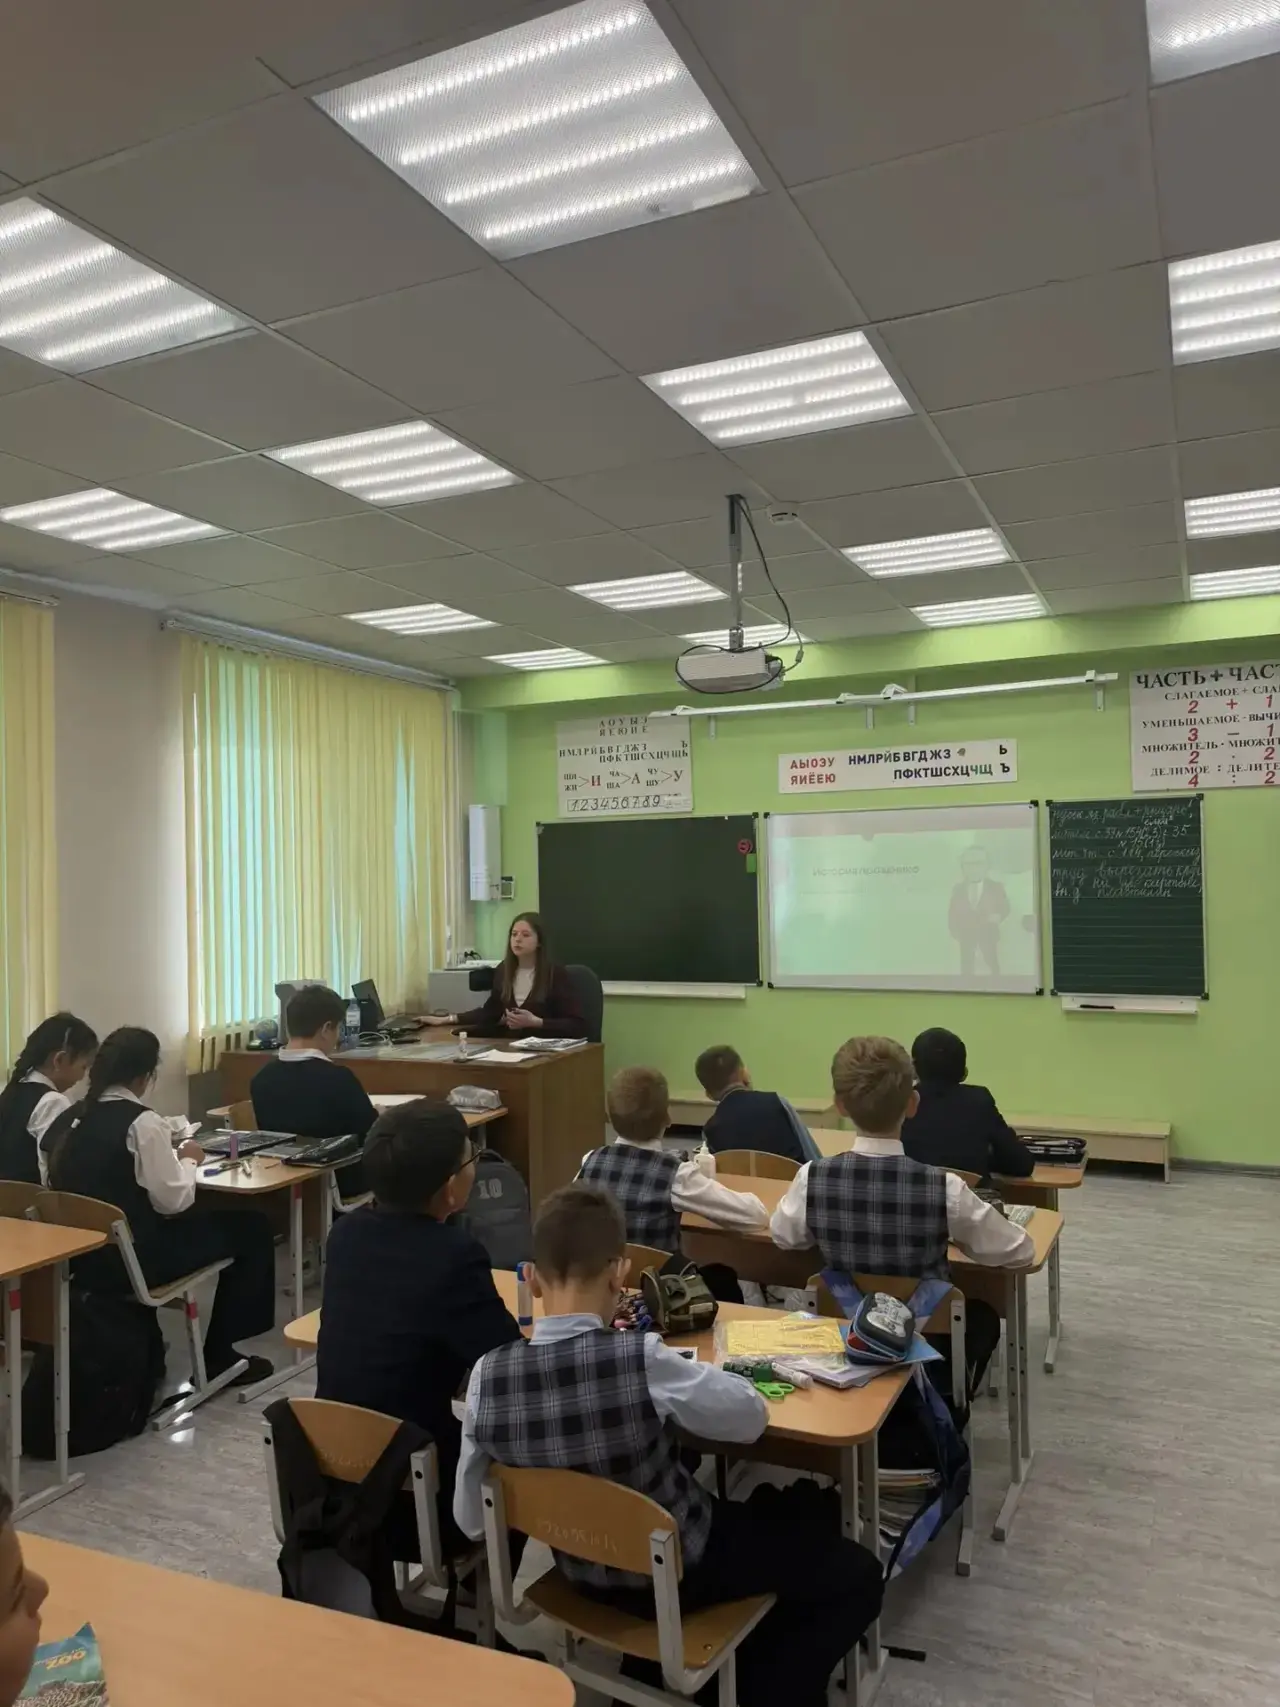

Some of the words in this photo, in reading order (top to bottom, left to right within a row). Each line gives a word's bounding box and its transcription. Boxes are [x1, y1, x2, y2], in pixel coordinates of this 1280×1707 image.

[1136, 670, 1206, 689] ЧАСТЬ
[1164, 687, 1239, 701] СЛАГАЕМОЕ
[1252, 685, 1280, 694] СЛА
[1188, 700, 1199, 714] 2
[1266, 694, 1273, 708] 1
[1142, 714, 1240, 729] УМЕНЬШАЕМОЕ
[1188, 727, 1199, 742] 3
[1267, 723, 1274, 738] 1
[999, 744, 1008, 755] Ь
[1142, 740, 1218, 754] МНОЖИТЕЛЬ
[1189, 750, 1200, 765] 2
[1264, 746, 1276, 760] 2
[1000, 762, 1010, 774] Ъ
[1150, 765, 1210, 777] ДЕЛИМОЕ
[591, 775, 601, 787] И
[631, 773, 641, 785] А
[673, 769, 684, 782] У
[1188, 774, 1199, 787] 4
[1264, 770, 1276, 784] 2
[477, 1178, 504, 1200] 10
